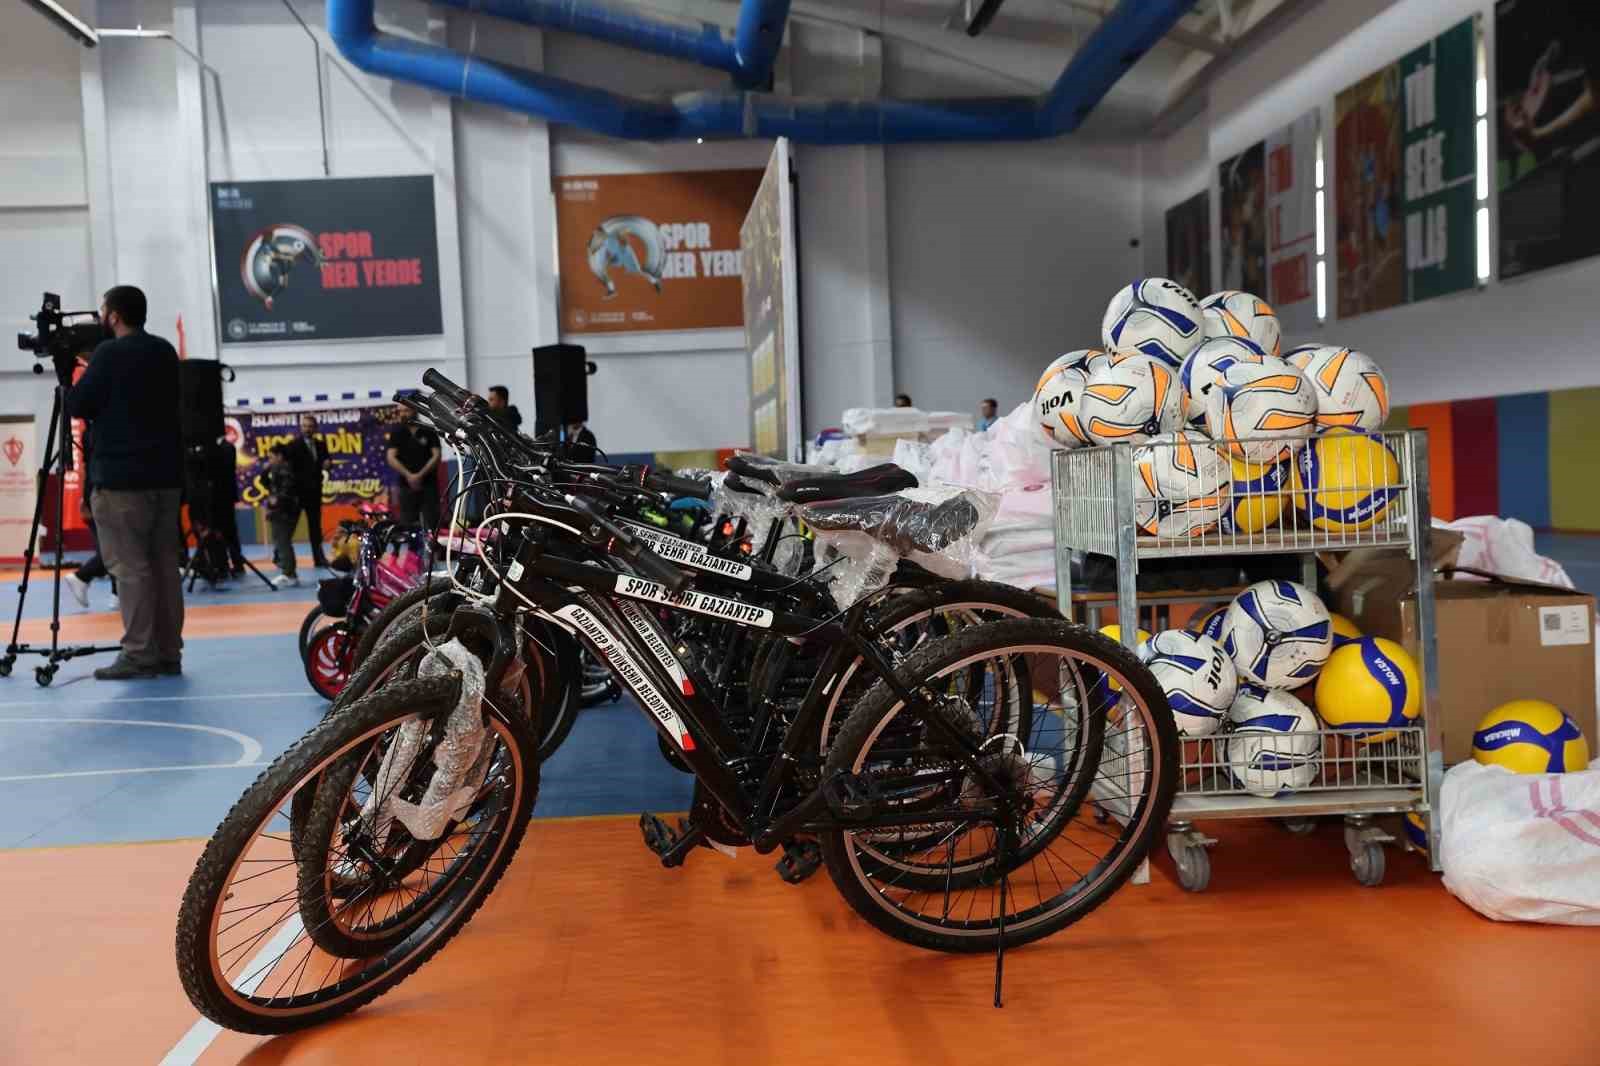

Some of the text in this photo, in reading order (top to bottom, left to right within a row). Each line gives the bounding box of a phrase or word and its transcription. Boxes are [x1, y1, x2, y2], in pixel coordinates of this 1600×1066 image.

[318, 231, 374, 259] SPOR
[658, 222, 712, 249] SPOR
[362, 257, 424, 288] YERDE
[701, 250, 743, 277] YER
[690, 554, 744, 576] GAZİANTEP
[625, 578, 659, 599] SPOR
[700, 596, 764, 623] GAZİANTEP
[570, 608, 609, 647] GAZİANTEP
[639, 684, 674, 722] BELEDİYESİ
